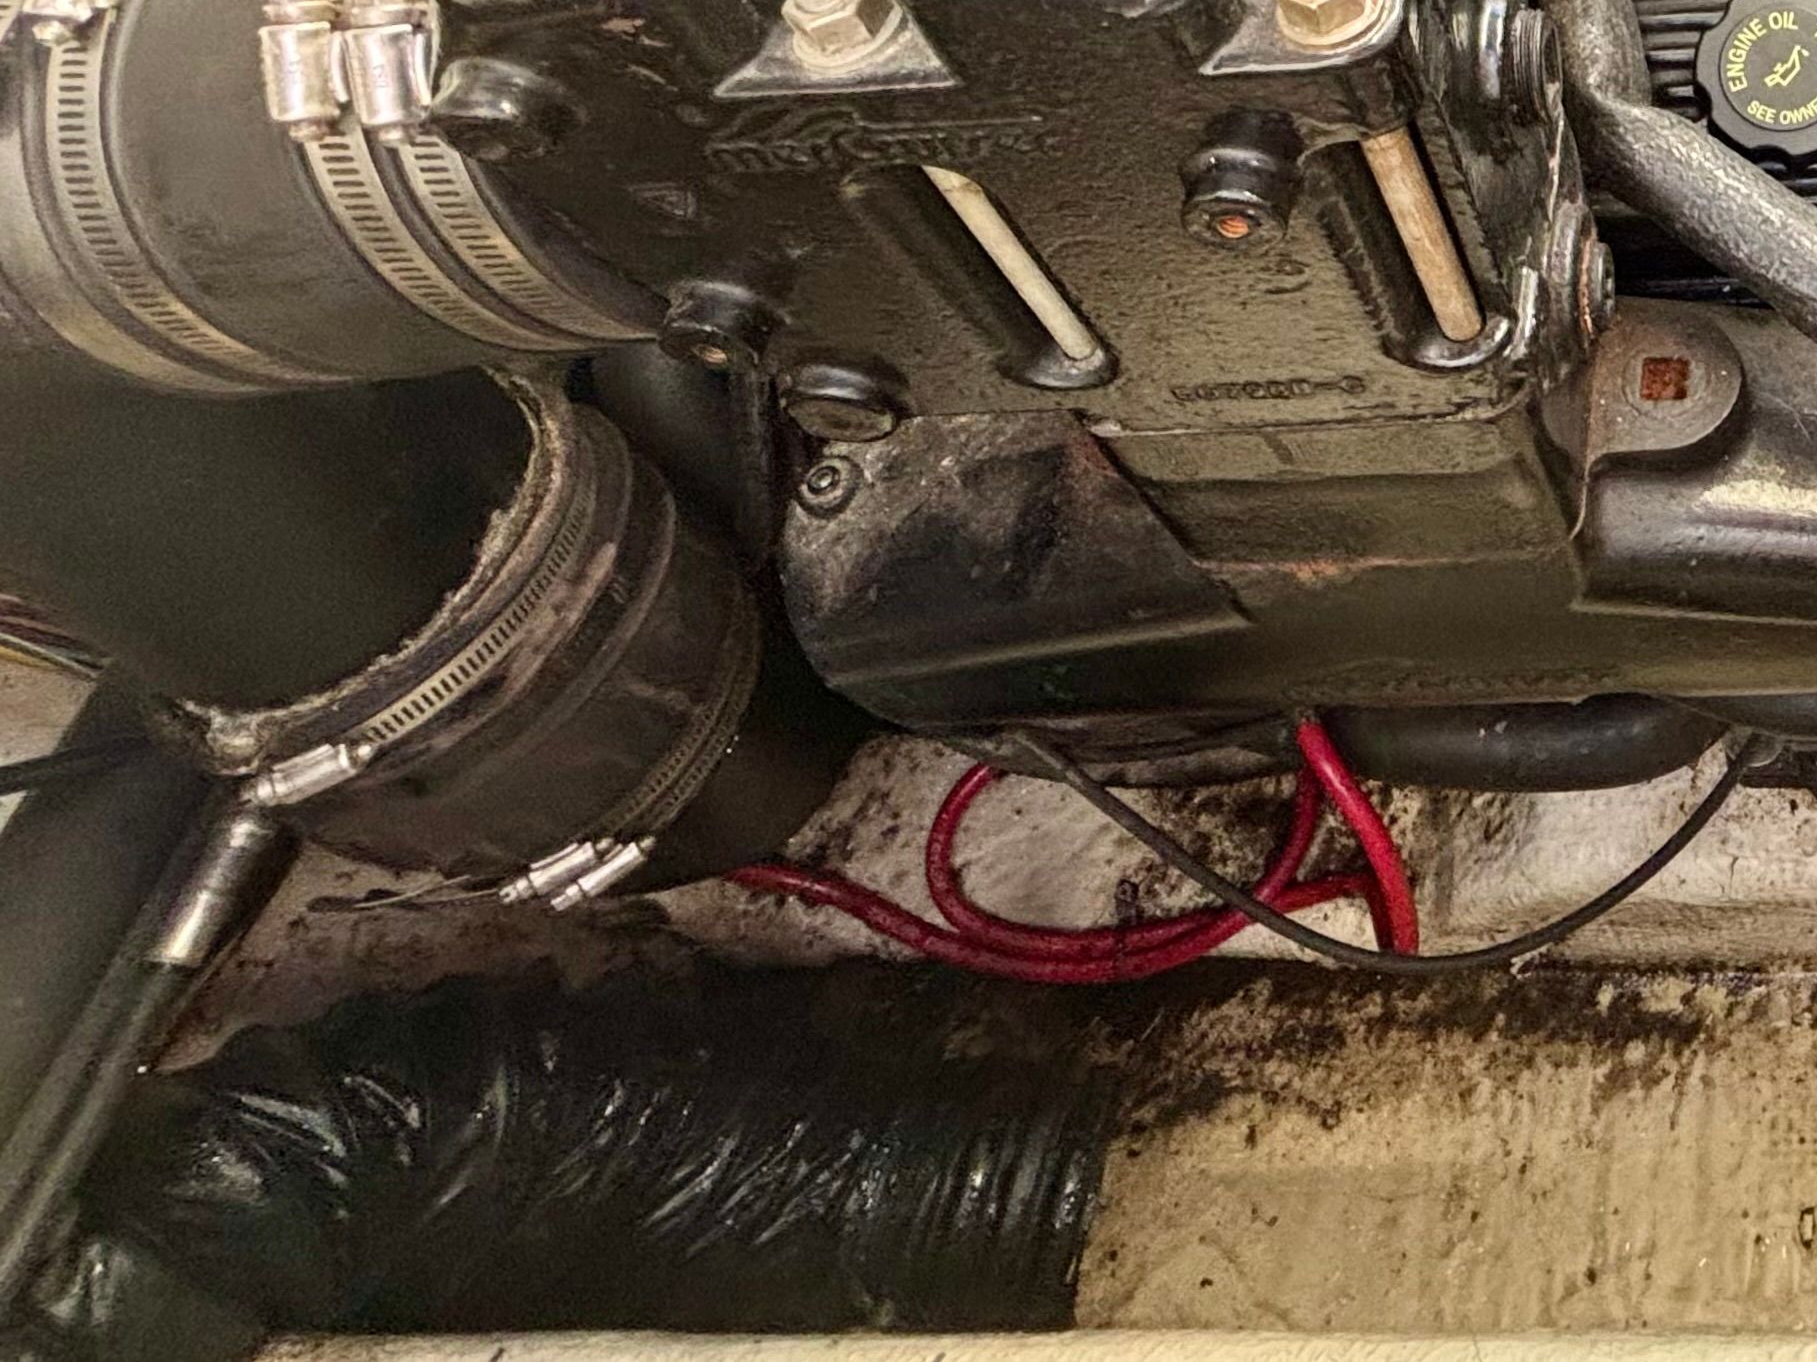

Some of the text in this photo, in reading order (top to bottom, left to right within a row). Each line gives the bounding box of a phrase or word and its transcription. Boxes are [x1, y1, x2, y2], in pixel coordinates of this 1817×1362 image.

[1725, 10, 1799, 93] ENGINE OIL
[1746, 99, 1777, 124] SEE
